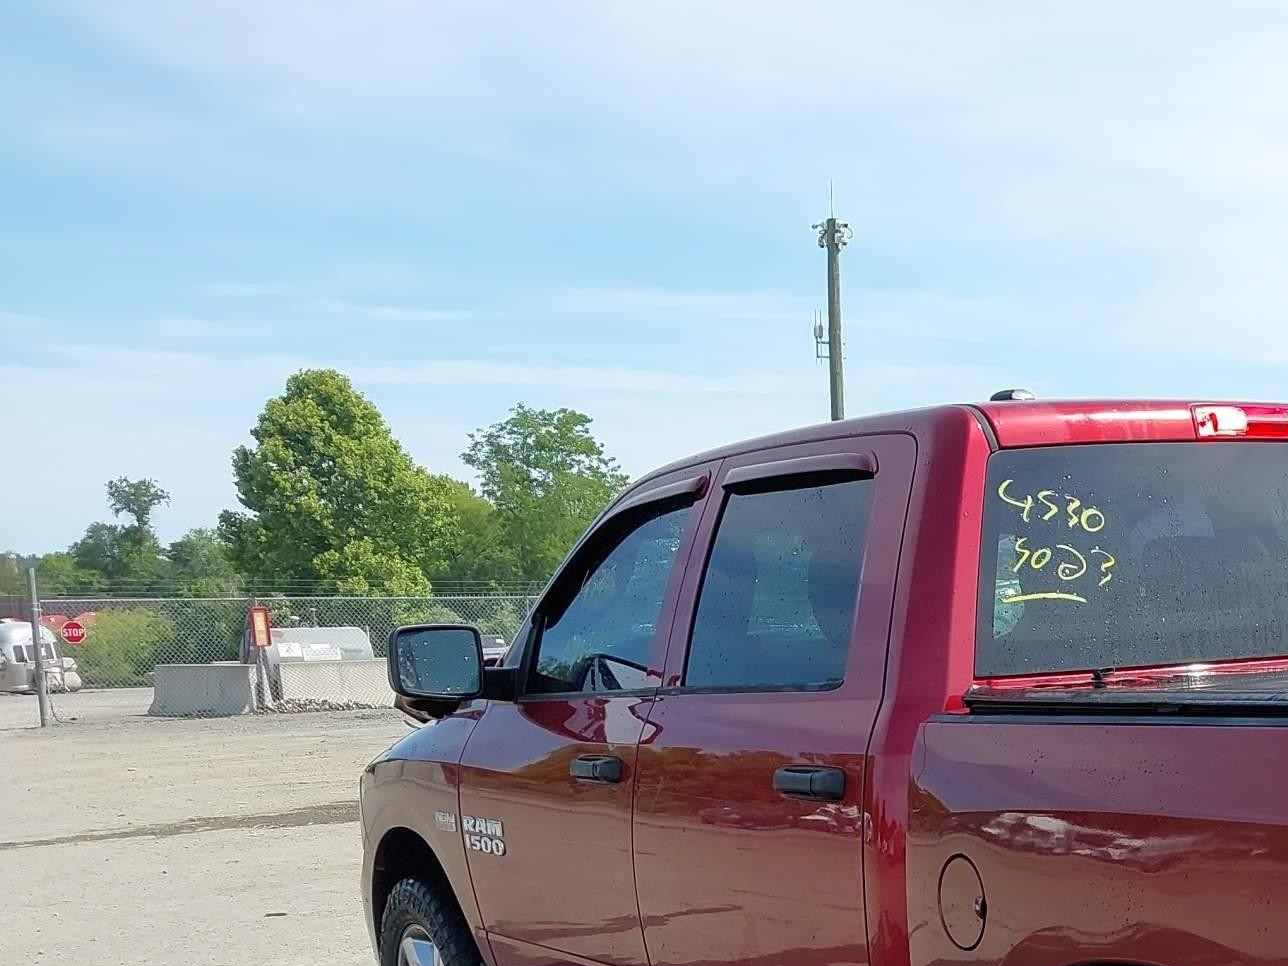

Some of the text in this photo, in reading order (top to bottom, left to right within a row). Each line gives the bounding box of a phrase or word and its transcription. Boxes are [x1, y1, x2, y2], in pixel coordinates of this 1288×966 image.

[998, 479, 1105, 532] 4530
[1012, 537, 1116, 586] 5023
[63, 628, 84, 637] STOP
[463, 816, 504, 837] RAM
[464, 834, 507, 856] 1500
